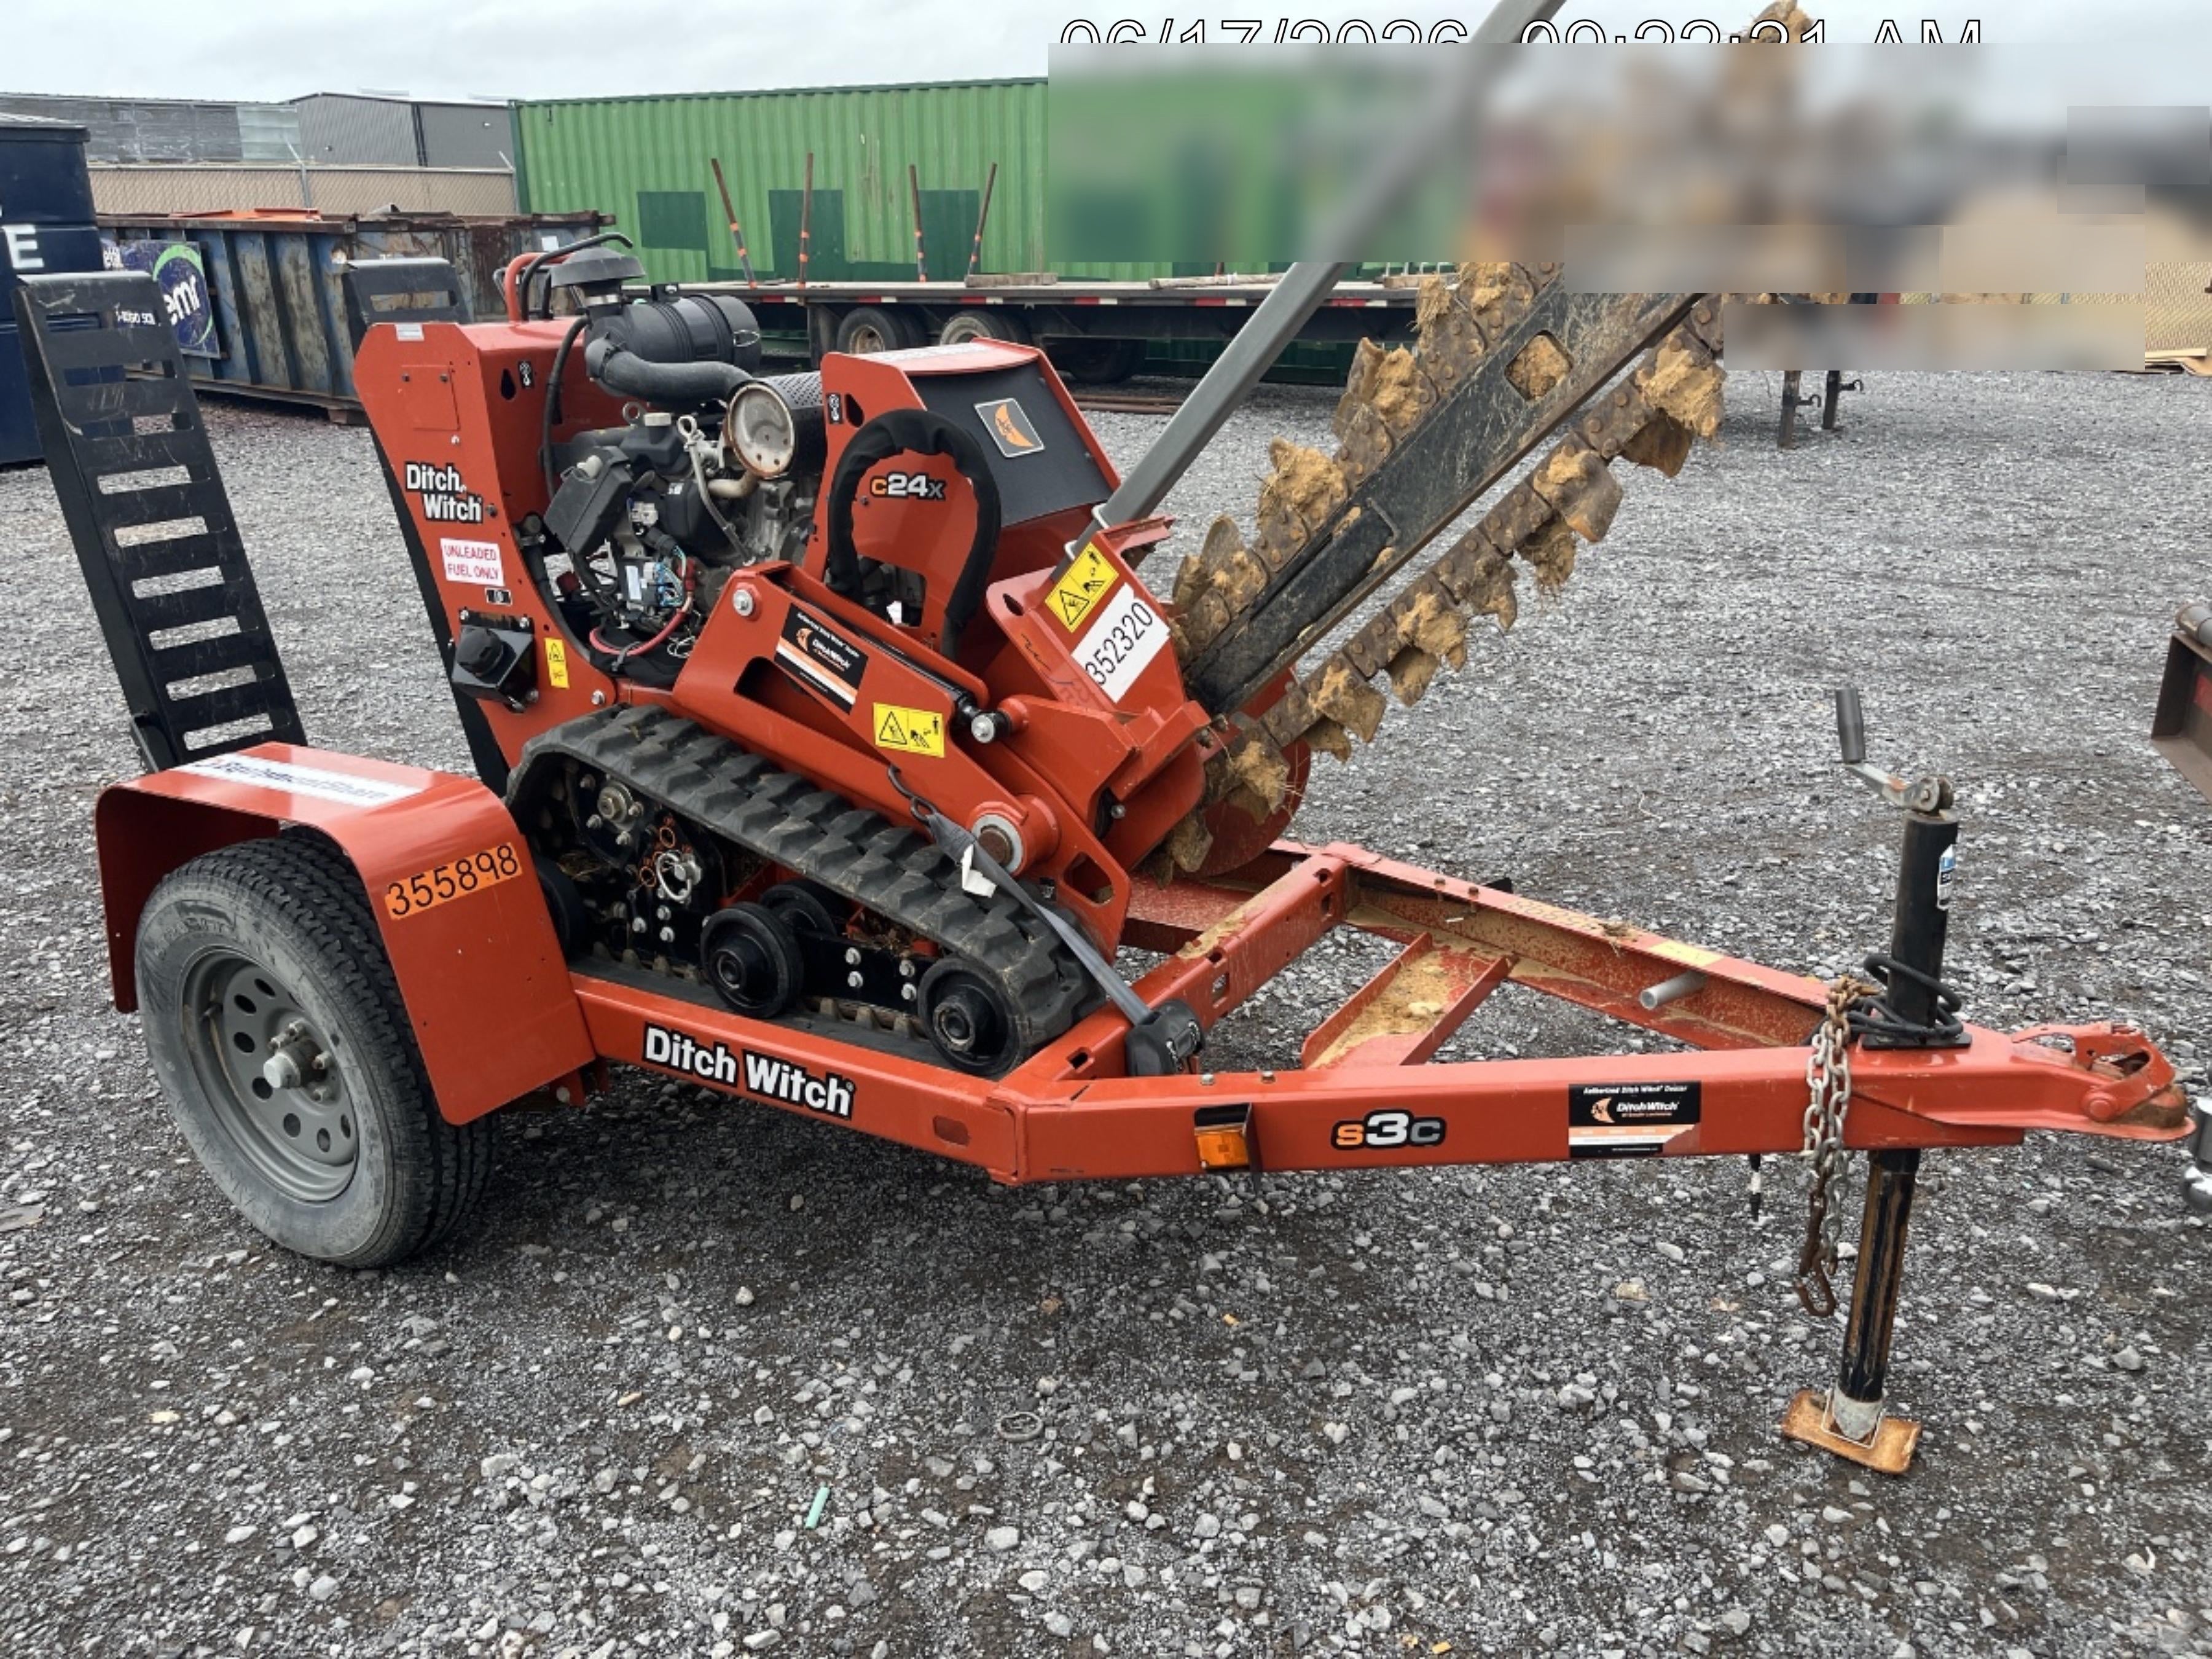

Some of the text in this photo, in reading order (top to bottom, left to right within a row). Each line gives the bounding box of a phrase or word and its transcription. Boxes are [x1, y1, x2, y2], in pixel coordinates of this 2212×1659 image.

[406, 463, 461, 492] Ditch
[423, 493, 482, 522] Witch
[444, 544, 497, 561] UNLEADED
[447, 563, 500, 579] FUEL ONLY
[1085, 602, 1153, 685] 352320
[388, 845, 518, 916] 355898
[645, 1026, 852, 1116] Ditch Witch
